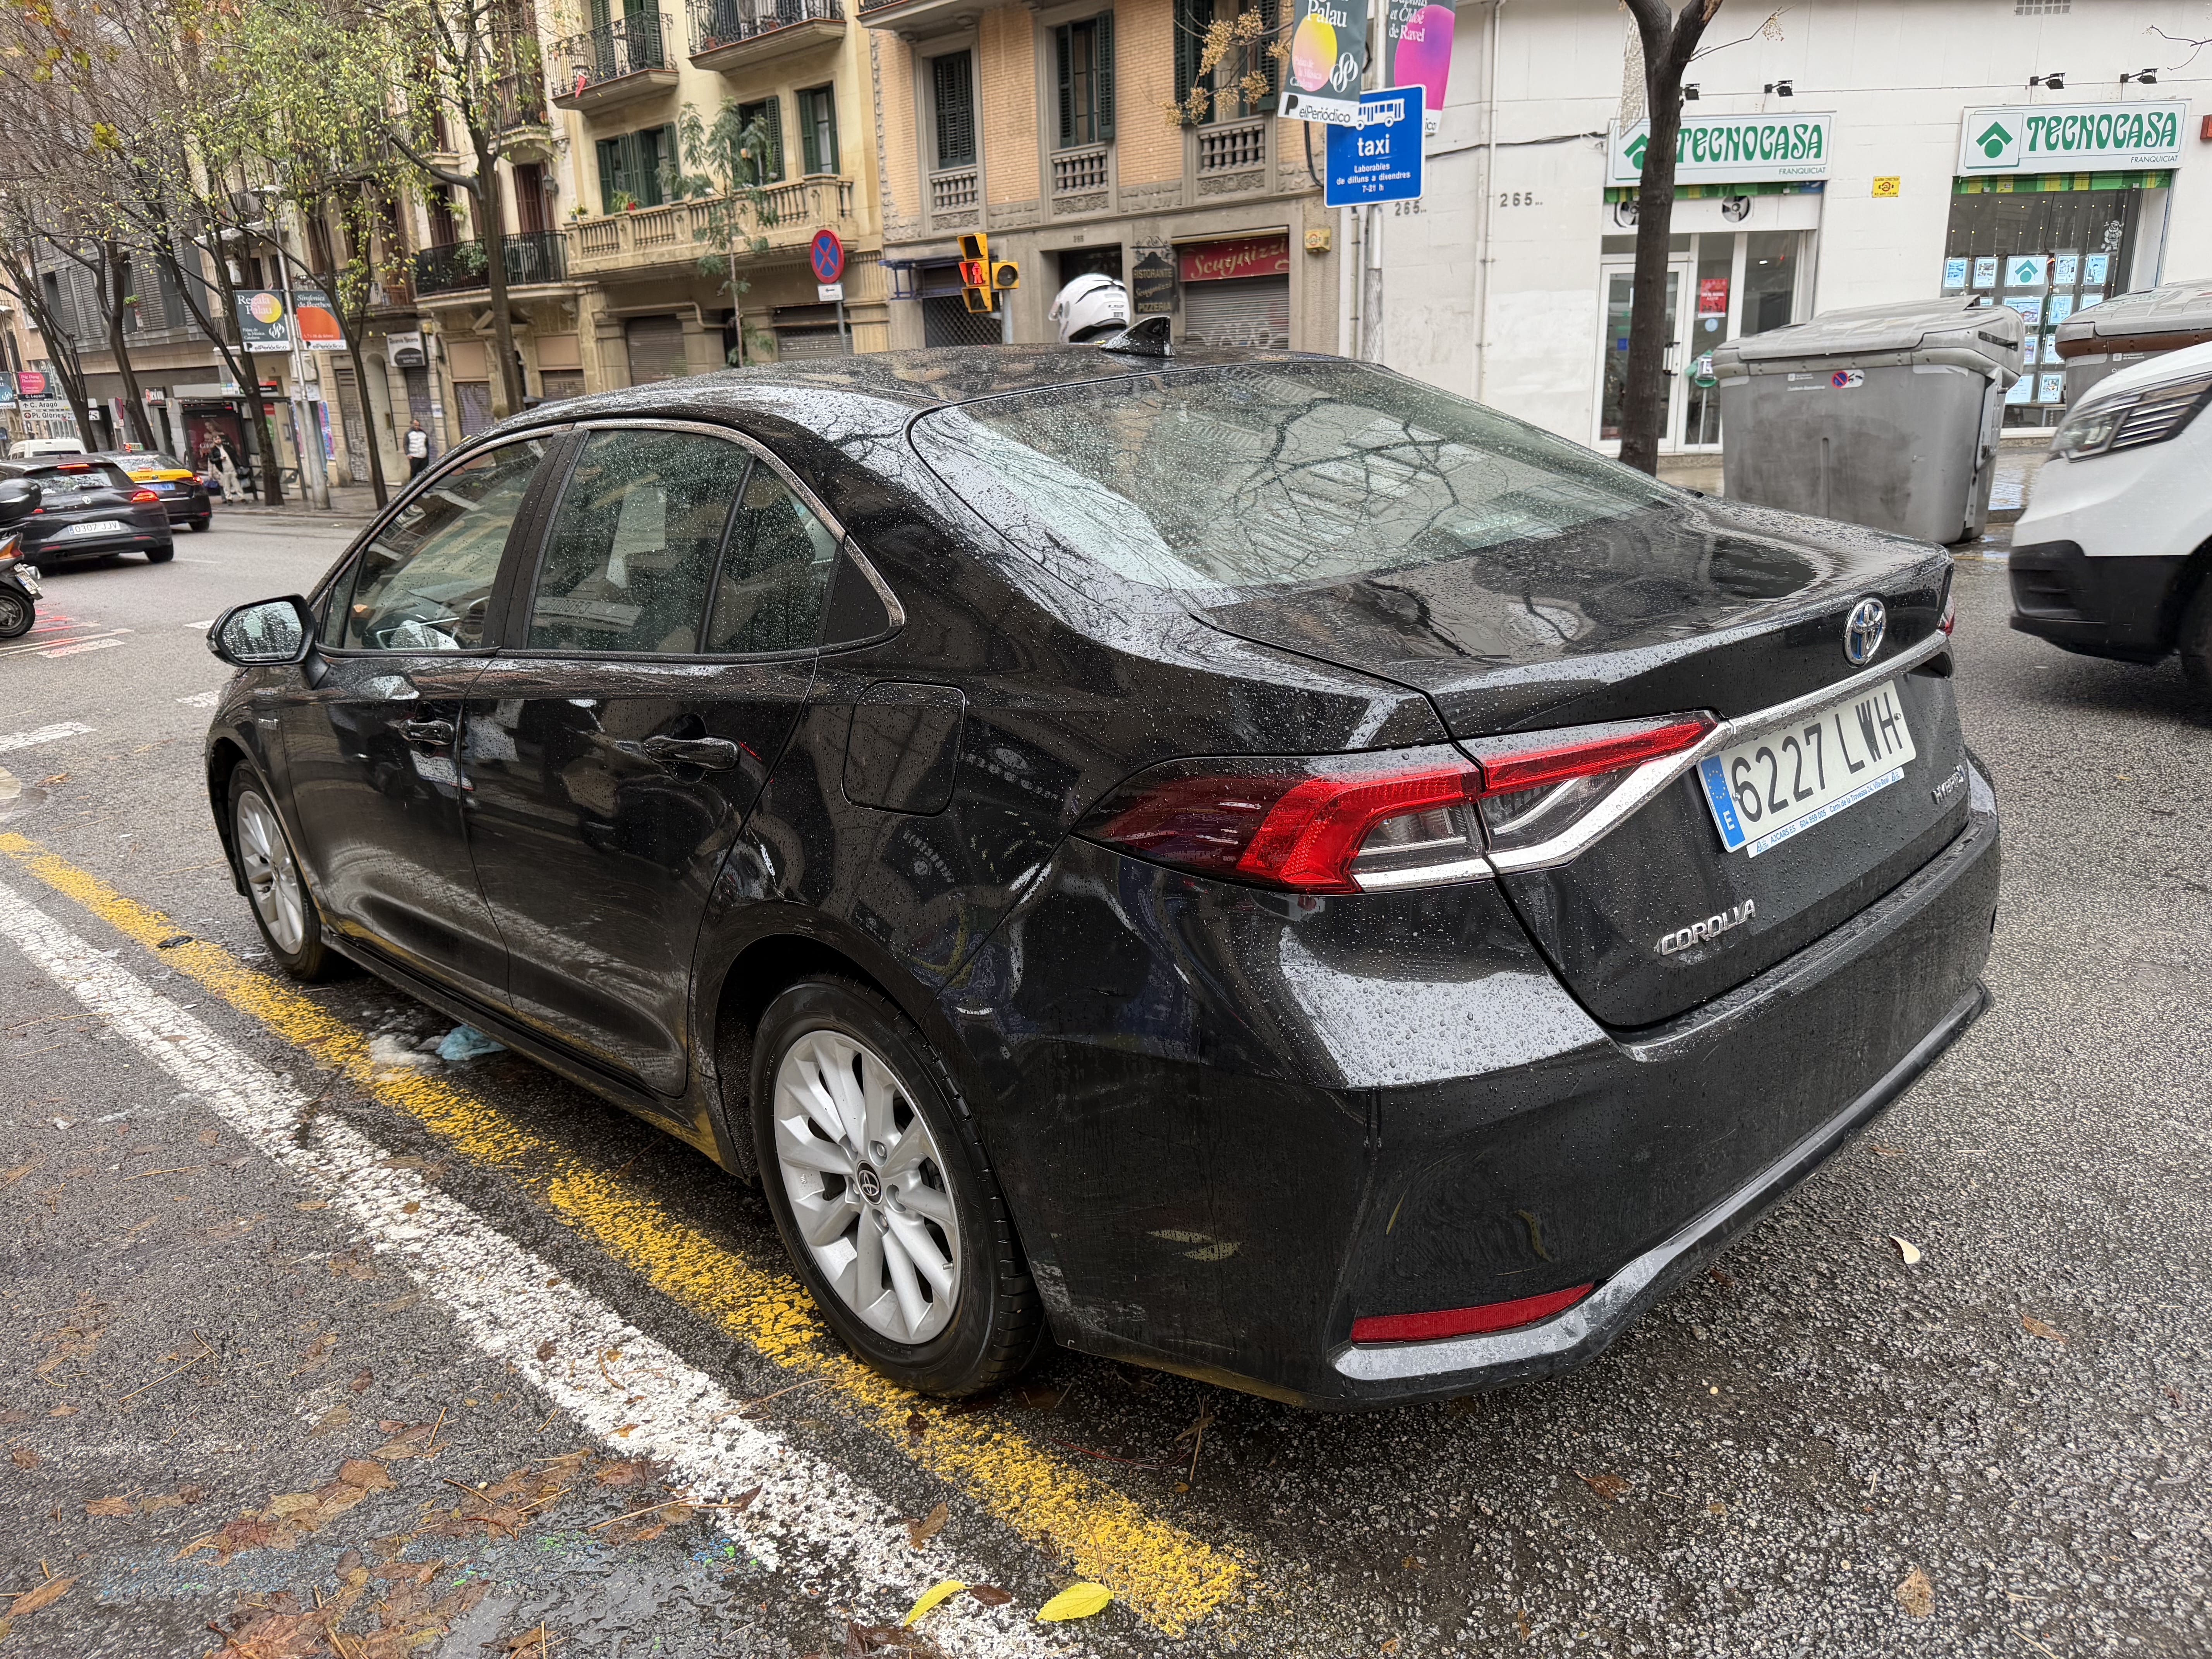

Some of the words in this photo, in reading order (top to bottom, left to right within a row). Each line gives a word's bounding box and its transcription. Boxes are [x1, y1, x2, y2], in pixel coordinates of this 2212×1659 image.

[1307, 0, 1348, 27] Palau
[1399, 7, 1425, 24] Chloé
[1389, 23, 1399, 38] de
[1400, 25, 1425, 42] Ravel
[1299, 104, 1351, 123] elPeriódico
[2027, 112, 2177, 151] TECNOCASA
[1357, 134, 1390, 156] taxi
[1676, 124, 1822, 163] TECNOCASA
[1354, 163, 1390, 173] Laborables
[2130, 155, 2178, 163] FRANQUICIAT
[1347, 175, 1369, 184] dilluns
[1378, 171, 1411, 181] divendres
[1778, 167, 1826, 175] FRANQUICIAT
[1394, 201, 1420, 216] 265
[1499, 192, 1533, 207] 265
[1190, 237, 1286, 279] Scugnizzi
[237, 295, 270, 307] Regala
[244, 305, 273, 315] Palau
[74, 524, 97, 533] 0307
[101, 521, 117, 530] JJV
[1731, 723, 1825, 822] 6227
[1835, 692, 1903, 774] LWH
[1723, 810, 1735, 830] E
[1771, 825, 1796, 844] AJCARS.ES
[1800, 818, 1809, 828] 604
[1809, 815, 1818, 823] 859
[1817, 809, 1827, 819] 005
[1658, 898, 1756, 956] COROLLA
